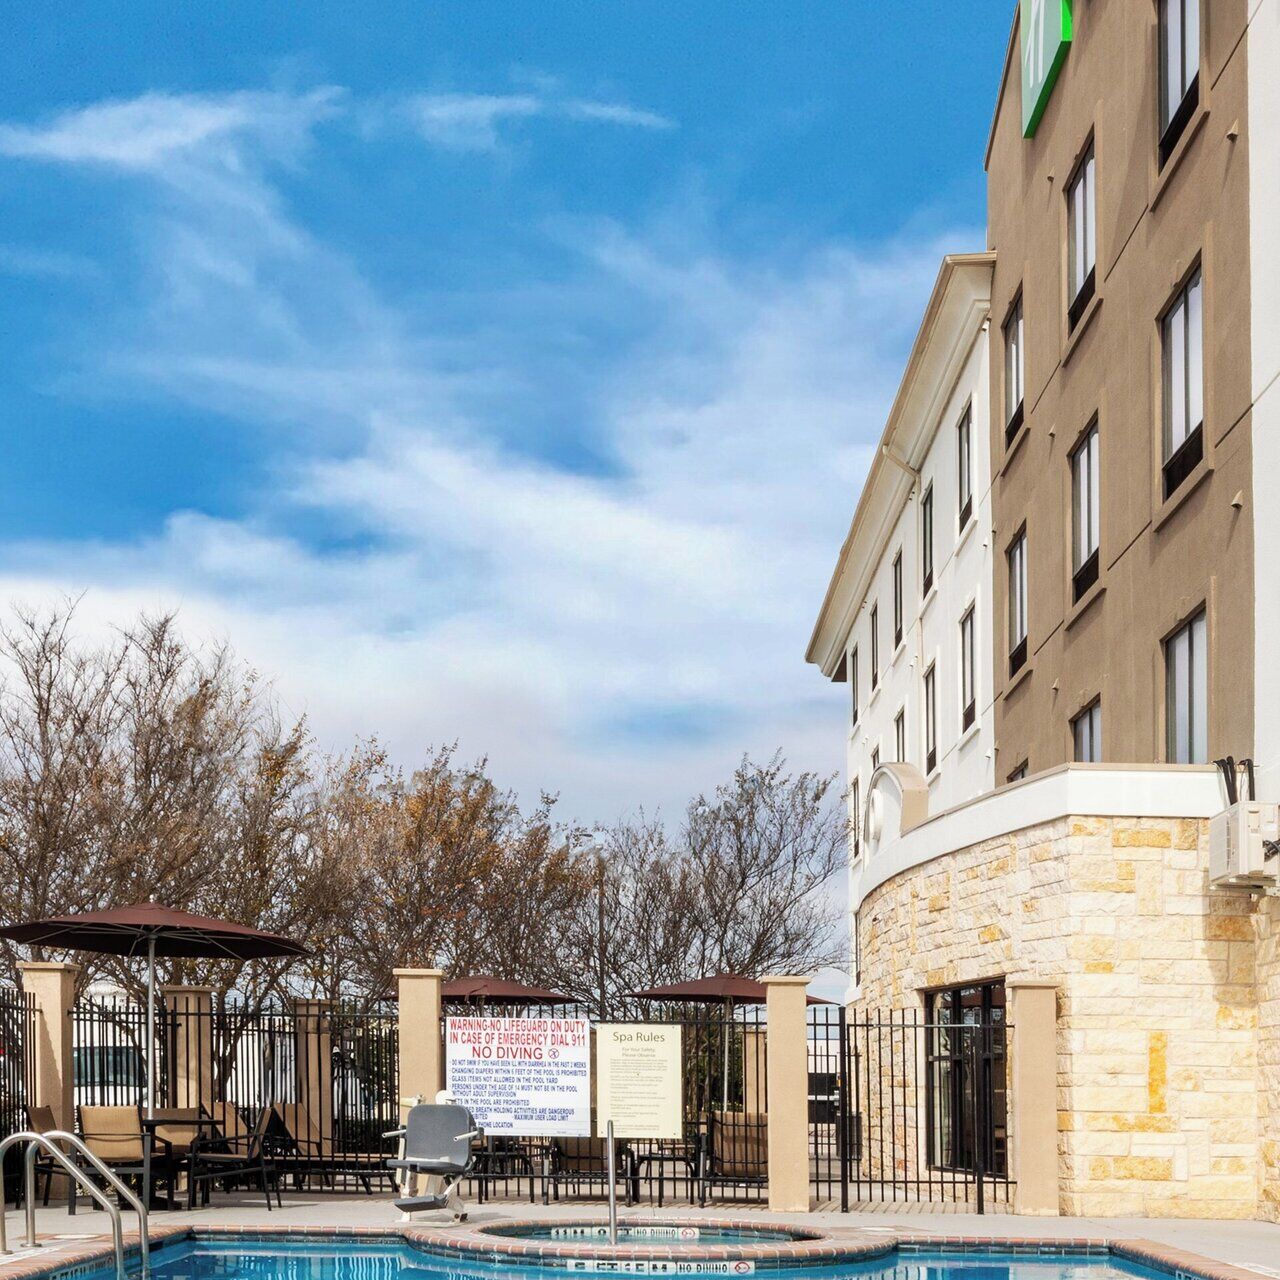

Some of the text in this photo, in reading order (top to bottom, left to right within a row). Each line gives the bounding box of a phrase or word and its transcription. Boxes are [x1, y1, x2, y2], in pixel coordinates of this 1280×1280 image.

[450, 1018, 585, 1033] WARNING-NO LIFEGUARD ON DUTY
[450, 1031, 586, 1047] IN CASE OF EMERGENCY DIAL 911
[612, 1031, 665, 1043] Spa Rules
[472, 1046, 543, 1060] NO DIVING
[679, 1263, 692, 1273] NO
